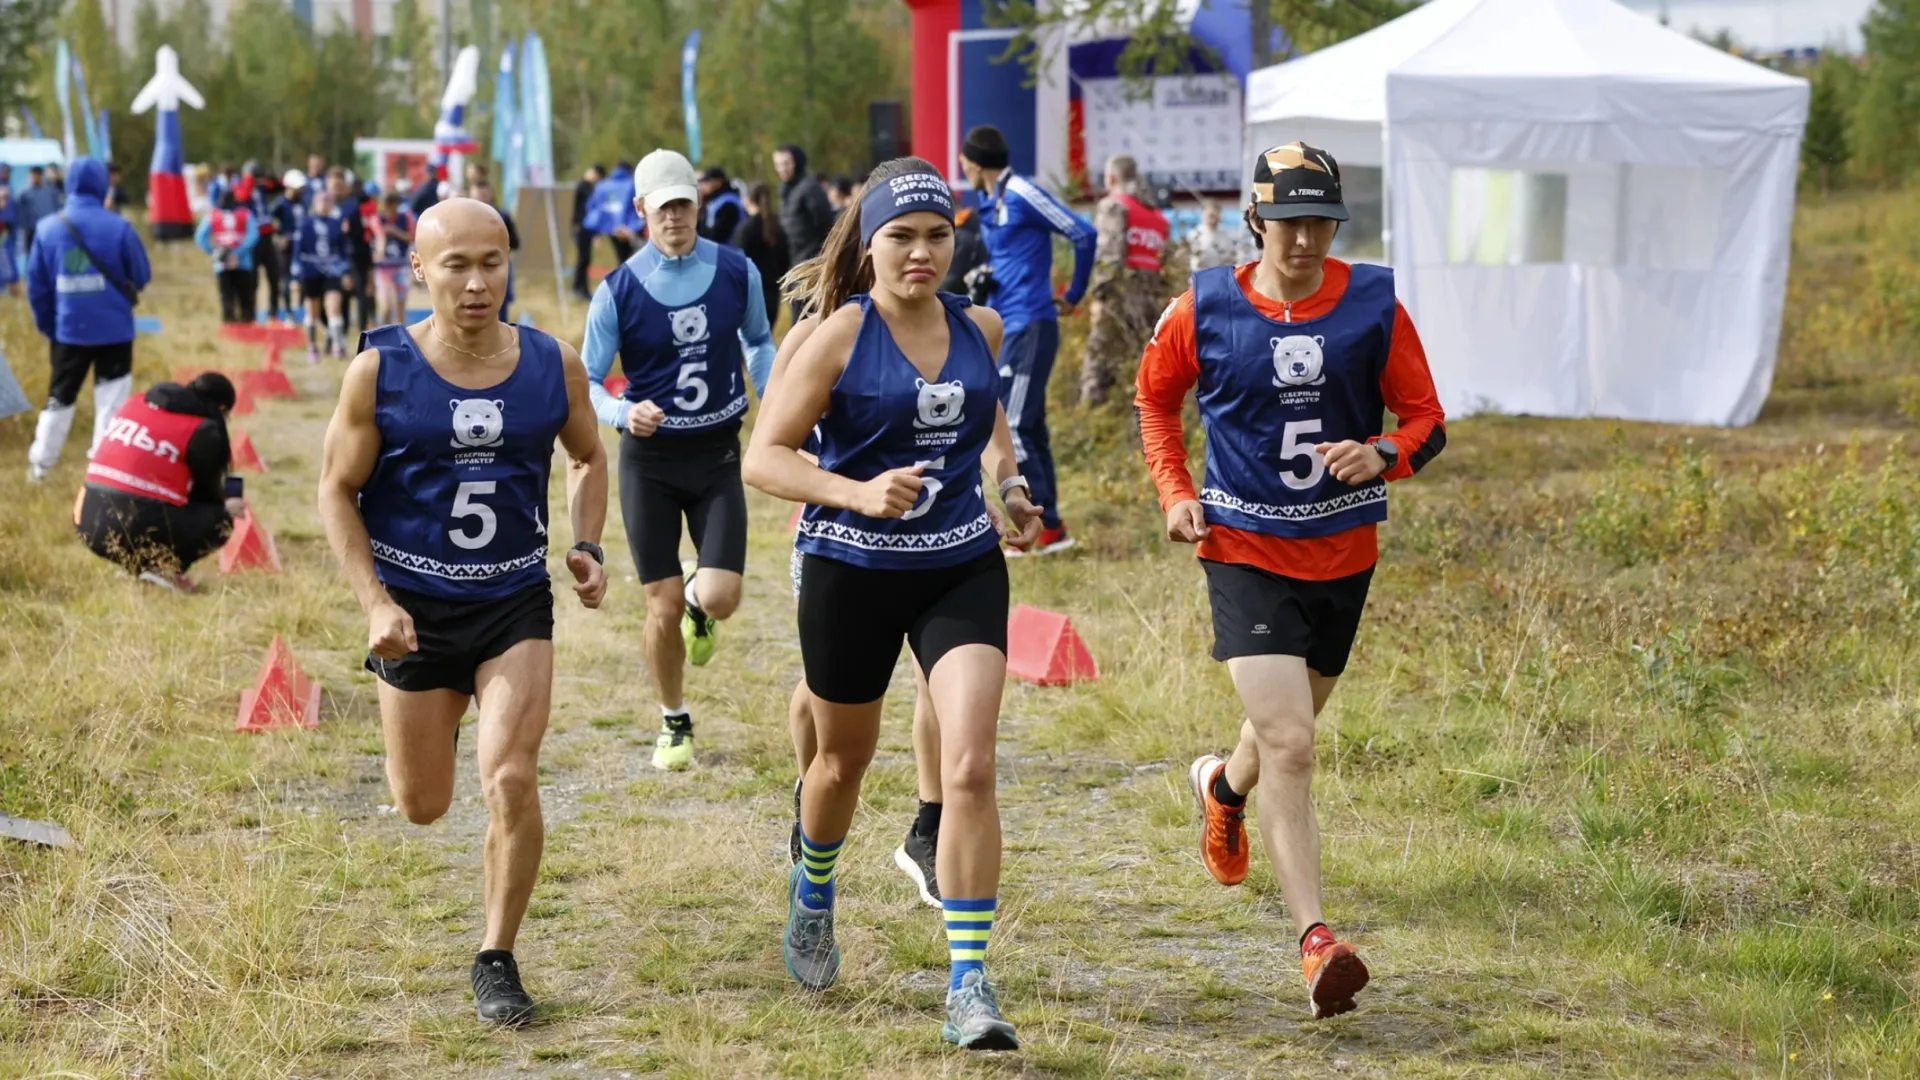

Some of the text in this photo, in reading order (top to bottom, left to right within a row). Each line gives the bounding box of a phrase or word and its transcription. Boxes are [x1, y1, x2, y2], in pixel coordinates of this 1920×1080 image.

[1298, 188, 1325, 197] TERREX
[895, 193, 929, 207] ЛЕТО
[673, 360, 709, 411] 5
[1278, 390, 1321, 399] СЕВЕРНЫЙ
[1280, 397, 1320, 406] ХАРАКТЕР
[914, 430, 958, 439] СЕВЕРНЫЙ
[915, 438, 957, 447] ХАРАКТЕР
[1278, 418, 1326, 490] 5
[454, 458, 495, 466] ХАРАКТЕР
[447, 480, 498, 550] 5
